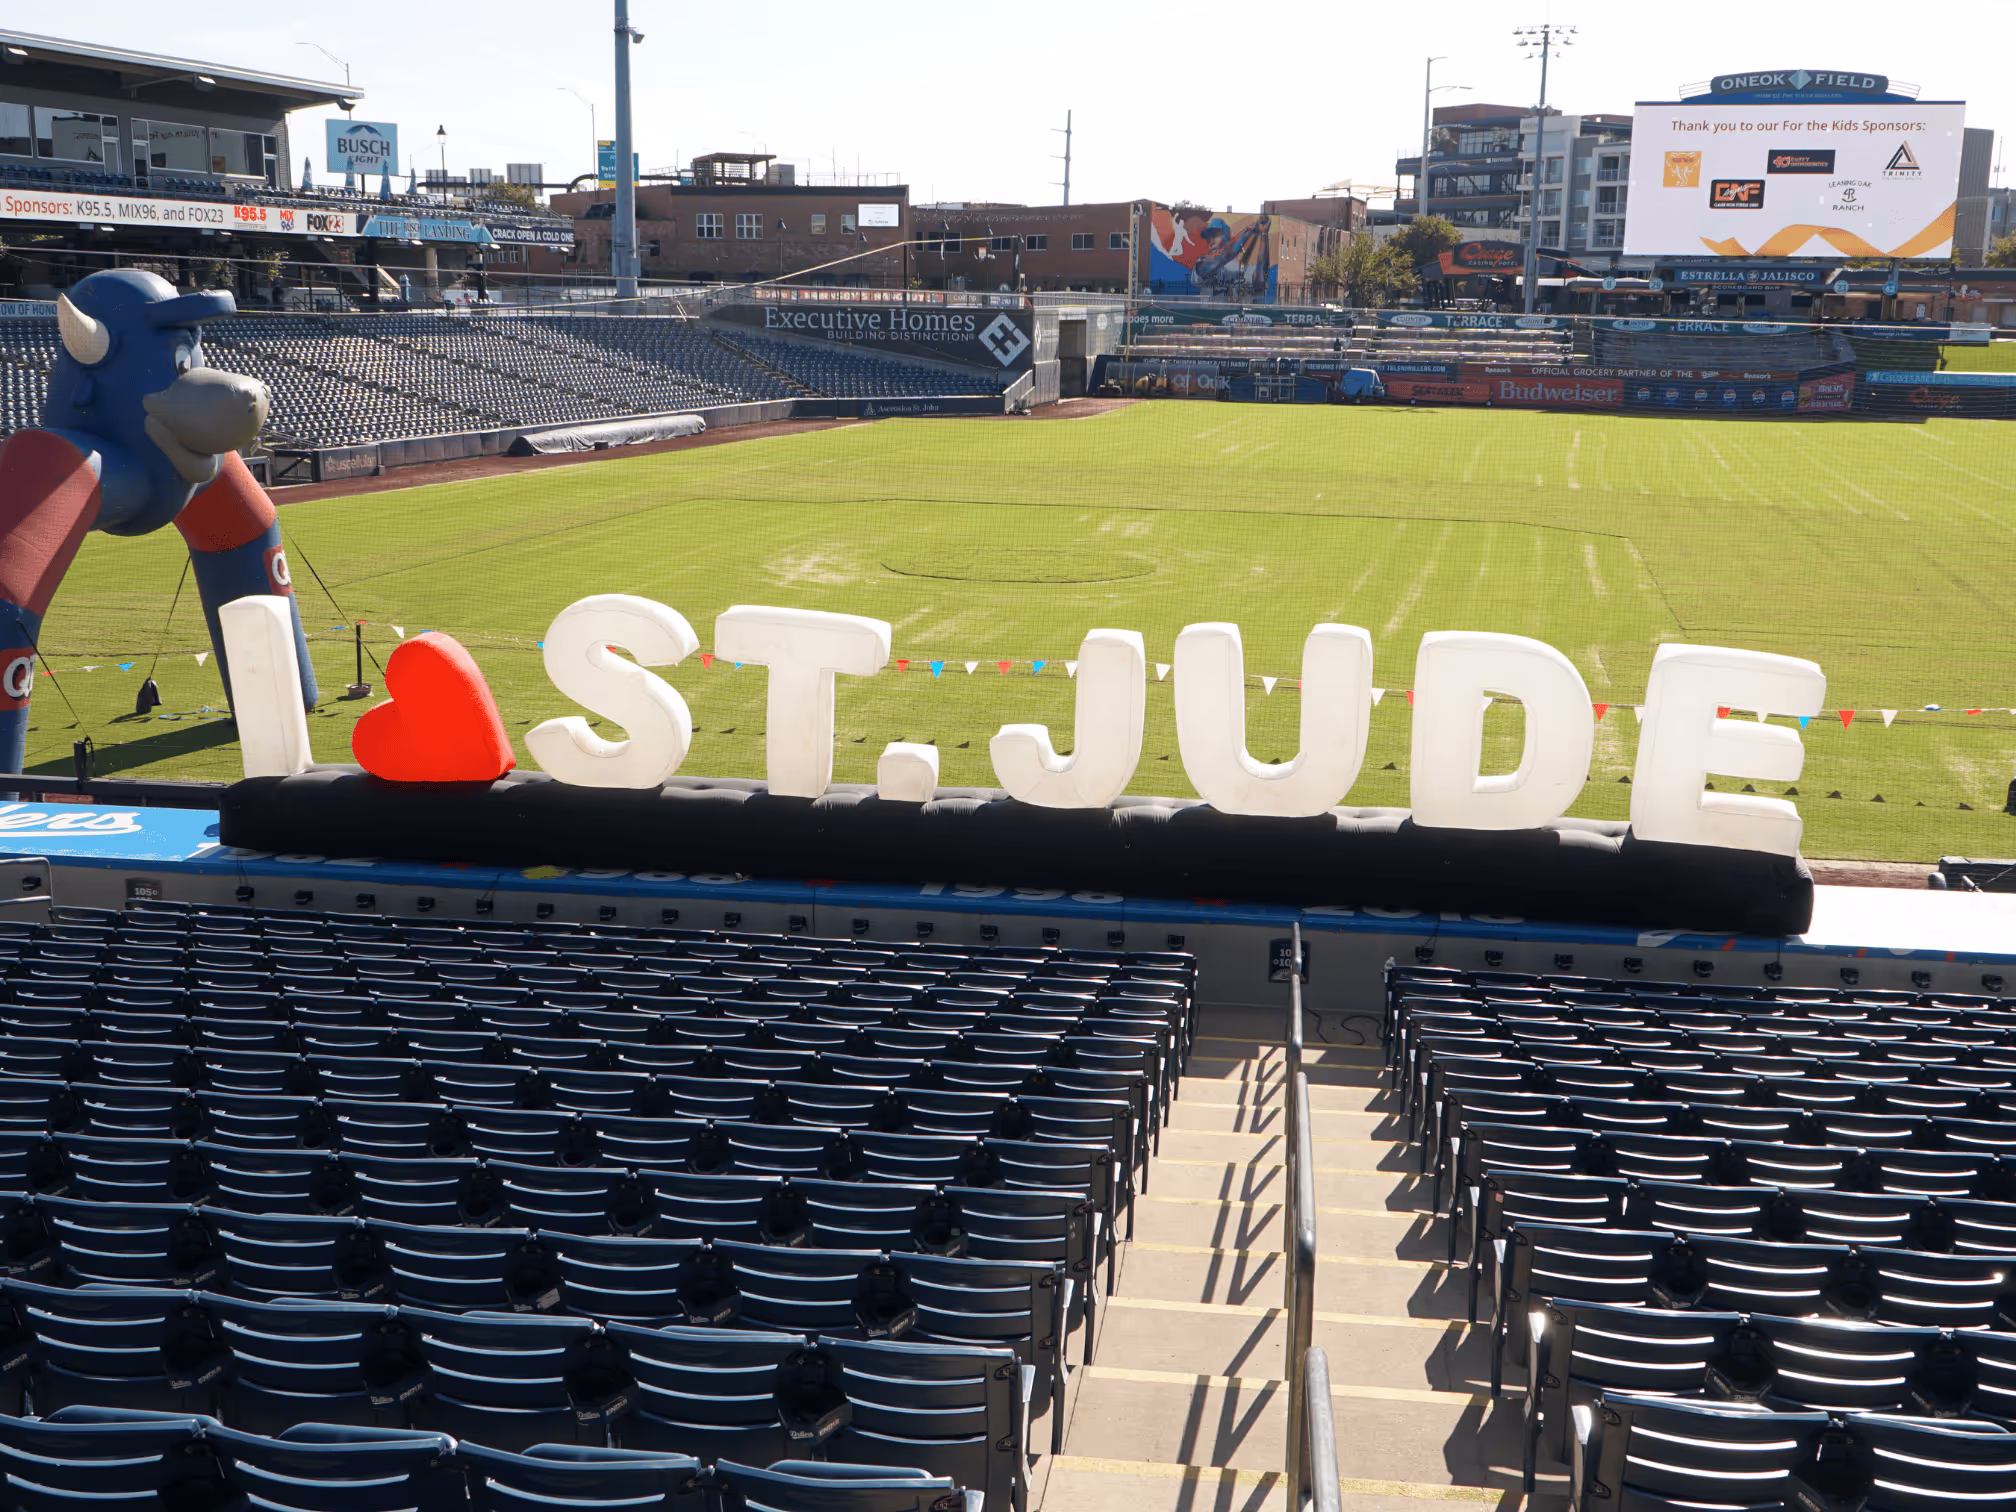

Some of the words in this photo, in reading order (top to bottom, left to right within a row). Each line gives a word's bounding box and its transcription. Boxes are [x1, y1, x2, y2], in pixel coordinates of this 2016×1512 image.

[1720, 73, 1786, 90] ONEOK
[1815, 73, 1876, 90] FIELD
[1671, 120, 1710, 132] Thank
[1712, 121, 1736, 134] you
[1740, 120, 1753, 132] to
[1756, 122, 1779, 131] our
[1782, 120, 1803, 131] For
[1807, 120, 1828, 131] the
[1832, 119, 1859, 131] Kids
[1862, 120, 1926, 134] Sponsors:
[337, 138, 391, 156] BUSCH
[354, 156, 380, 164] IGHT
[1828, 180, 1857, 188] LEANING
[1857, 180, 1873, 188] OAK
[6, 195, 73, 217] Sponsors:
[77, 199, 115, 219] K95.5,
[119, 202, 160, 222] MIX96,
[163, 206, 185, 221] and
[188, 207, 224, 223] FOX23
[234, 205, 267, 221] K95.5
[306, 213, 345, 233] FOX23
[376, 220, 401, 237] THE
[424, 225, 470, 241] LANDING
[492, 228, 516, 240] CRACK
[516, 230, 535, 241] OPEN
[536, 231, 542, 241] A
[542, 232, 560, 242] COLD
[561, 233, 574, 243] ONE
[1680, 271, 1746, 281] ESTRELLA
[1760, 271, 1815, 282] JALISCO
[0, 303, 16, 316] OW
[18, 303, 30, 316] OF
[32, 303, 58, 316] HONO
[764, 305, 881, 331] Executive
[888, 308, 976, 332] Homes
[1151, 316, 1175, 324] more
[827, 330, 887, 341] BUILDING
[1532, 367, 1570, 376] OFFICIAL
[1573, 368, 1614, 377] GROCERY
[1617, 369, 1657, 378] PARTNER
[1660, 370, 1673, 378] OF
[1676, 370, 1694, 378] THE
[1499, 380, 1618, 402] Budweiser
[878, 404, 912, 413] Ascension
[922, 403, 940, 412] John
[218, 593, 314, 778] I
[524, 593, 940, 801] ST.
[989, 621, 1828, 858] JUDE
[134, 887, 152, 896] 105
